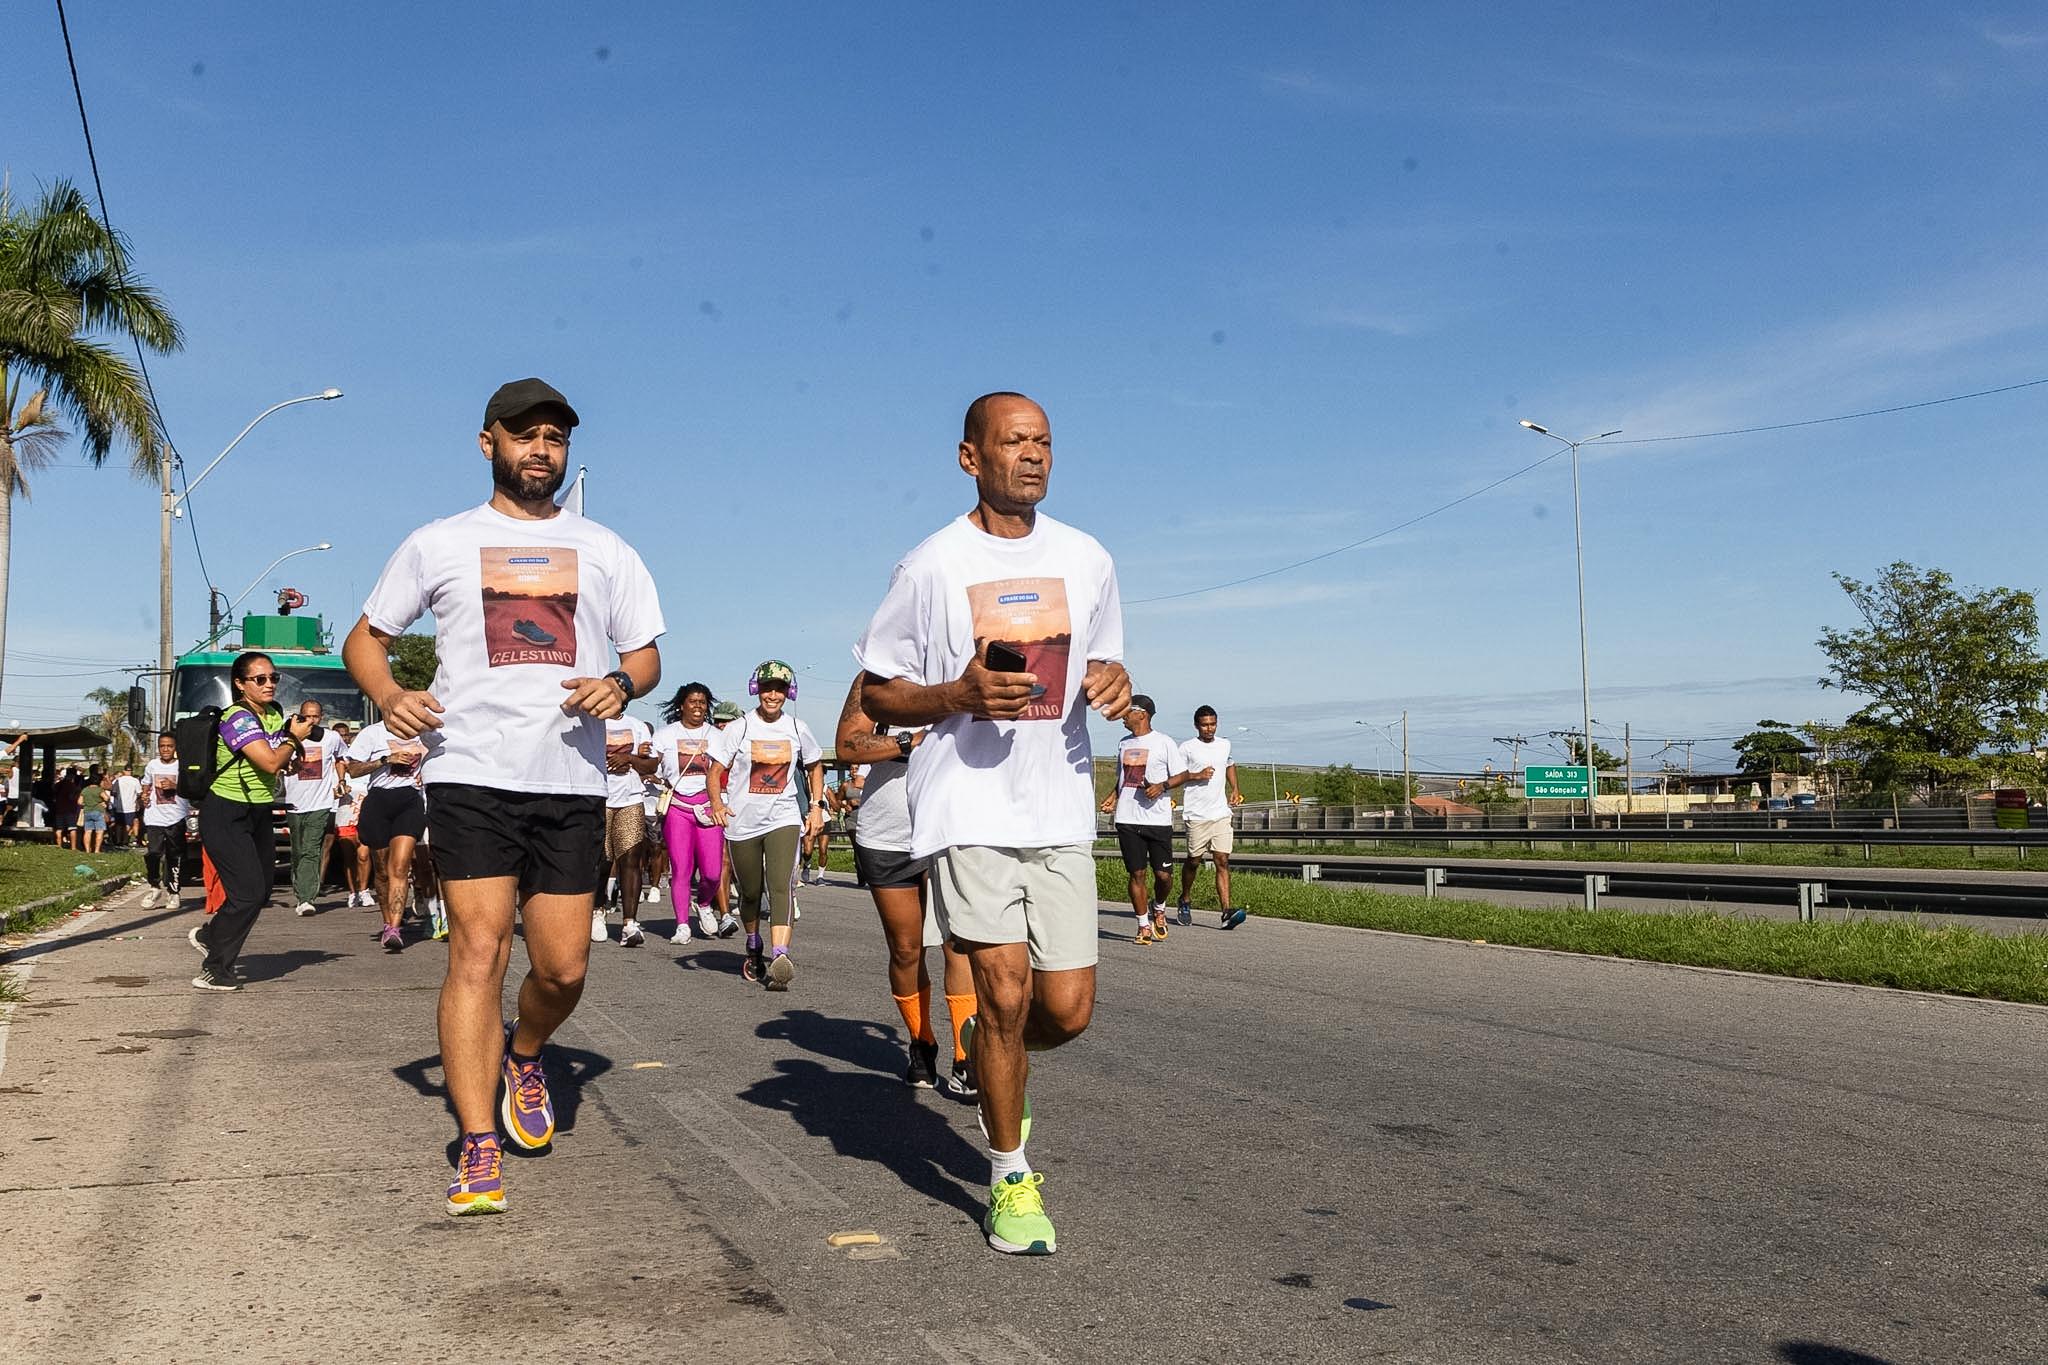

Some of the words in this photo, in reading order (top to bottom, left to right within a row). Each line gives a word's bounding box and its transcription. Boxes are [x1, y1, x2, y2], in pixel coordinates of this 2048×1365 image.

[491, 650, 573, 665] CELESTINO
[1545, 769, 1564, 778] SAÍDA
[1550, 786, 1577, 794] Gonçalo
